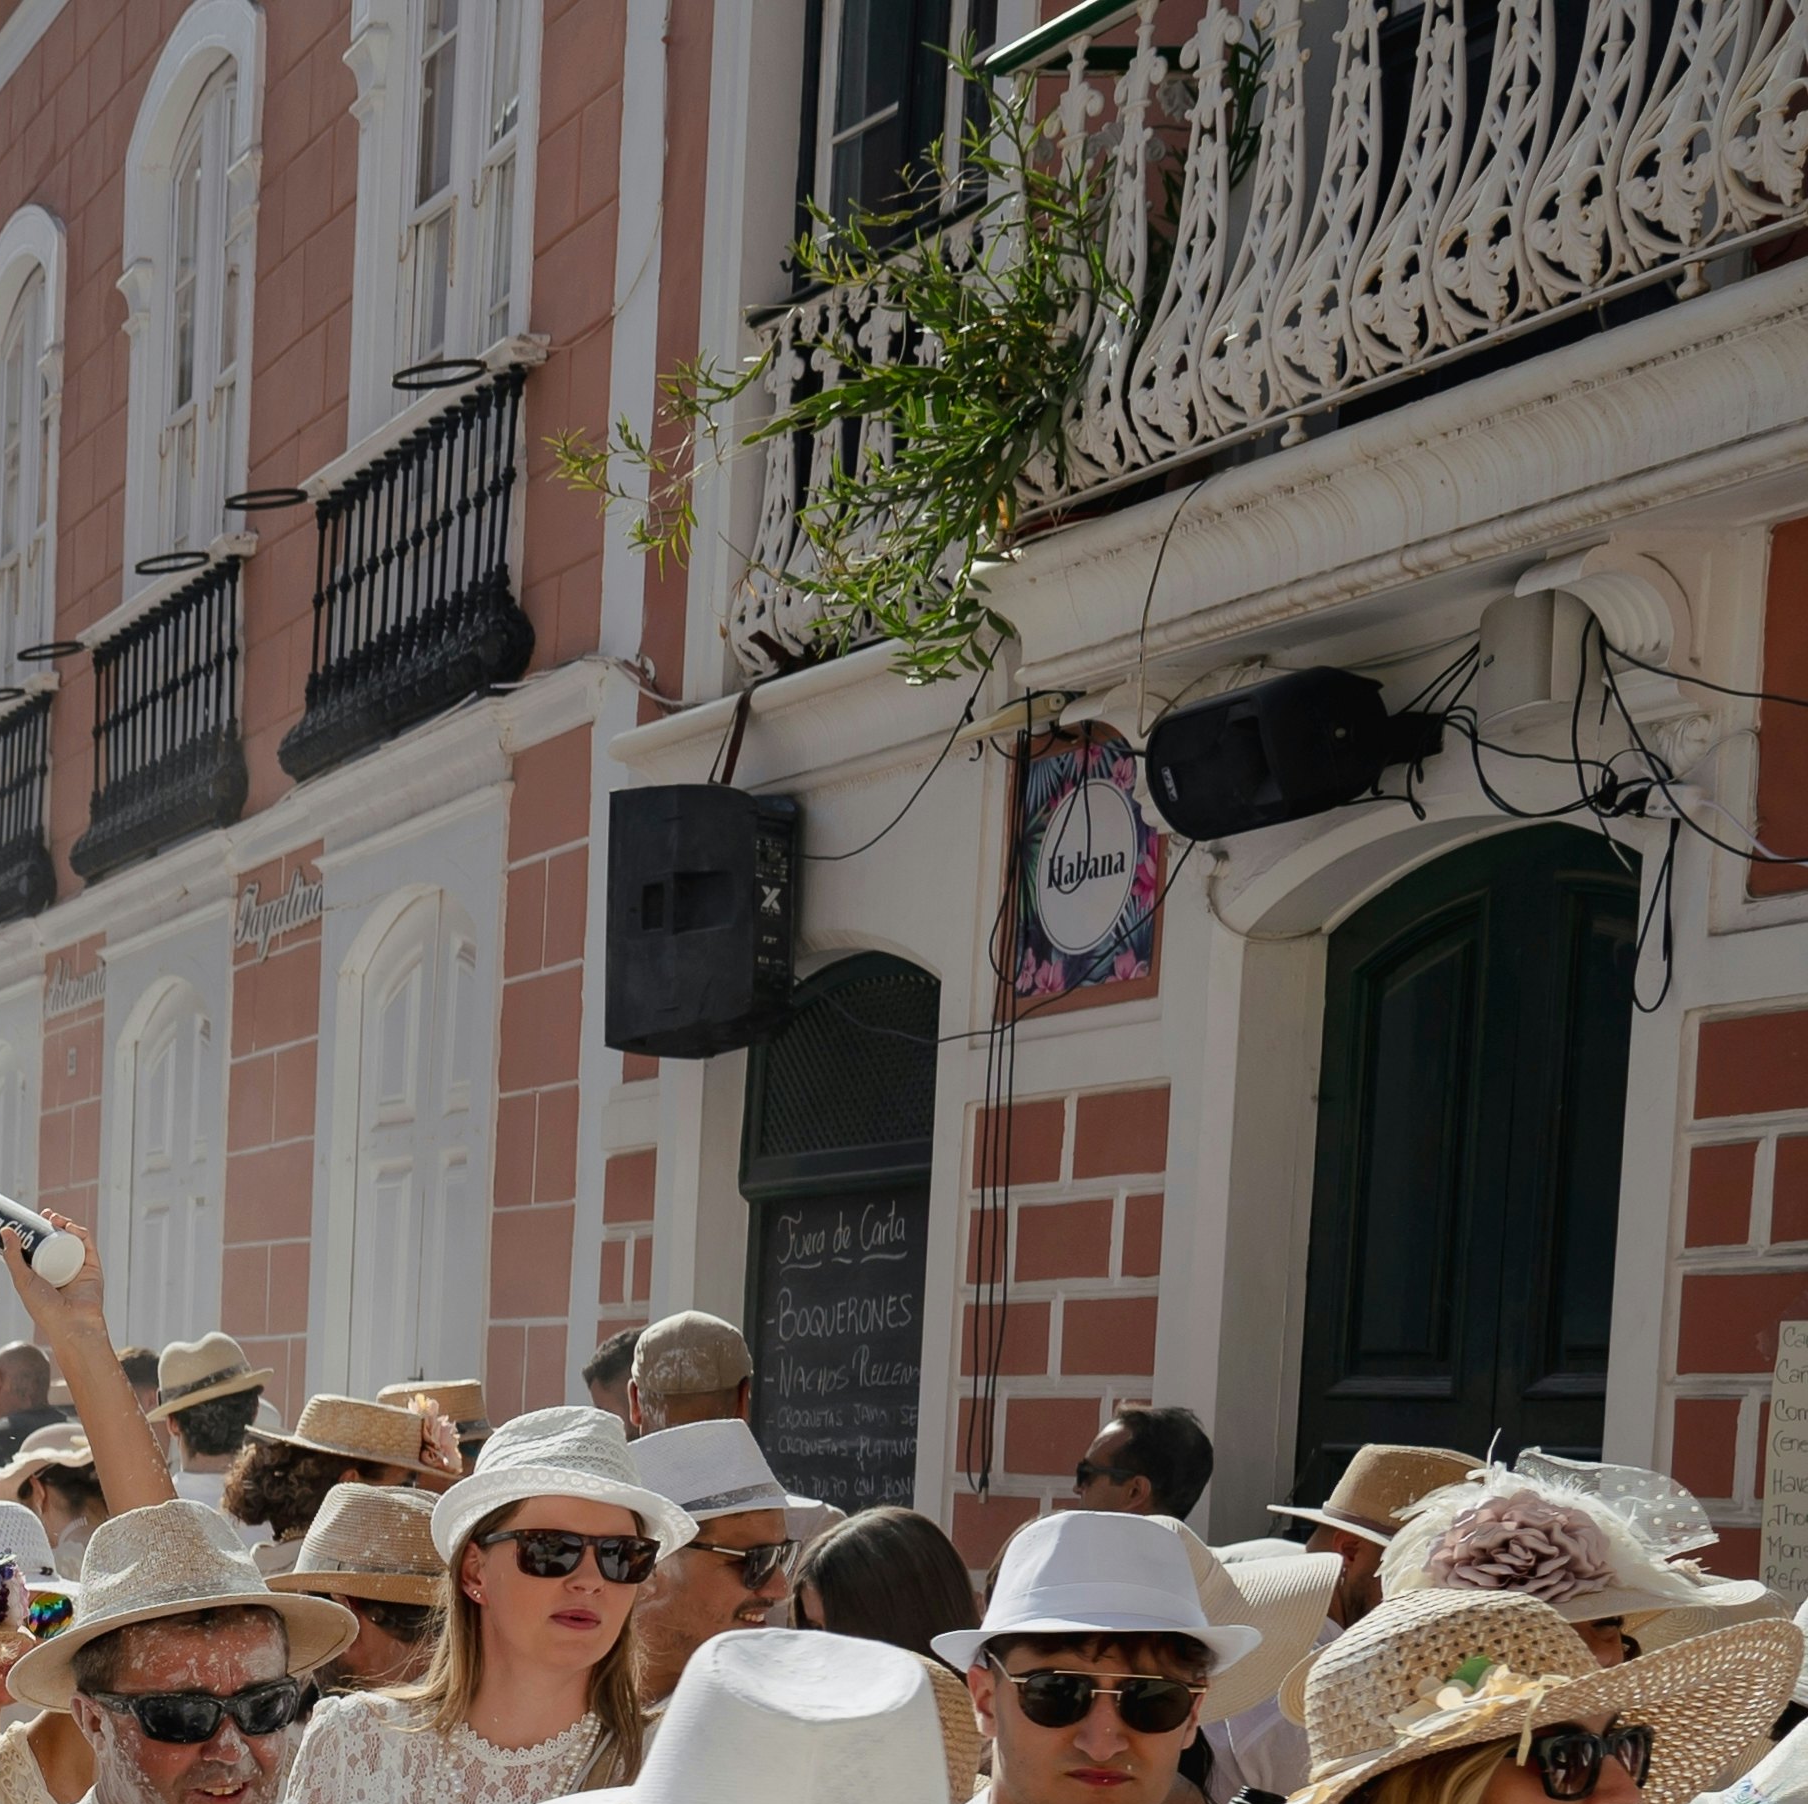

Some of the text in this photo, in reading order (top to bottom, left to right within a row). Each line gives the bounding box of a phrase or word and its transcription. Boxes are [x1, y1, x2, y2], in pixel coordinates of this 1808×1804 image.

[1047, 850, 1125, 890] Habana
[4, 1219, 36, 1251] Club
[776, 1200, 906, 1264] Fuera de Carta
[777, 1286, 913, 1342] BOQUERONES
[779, 1355, 849, 1399] NACHOS
